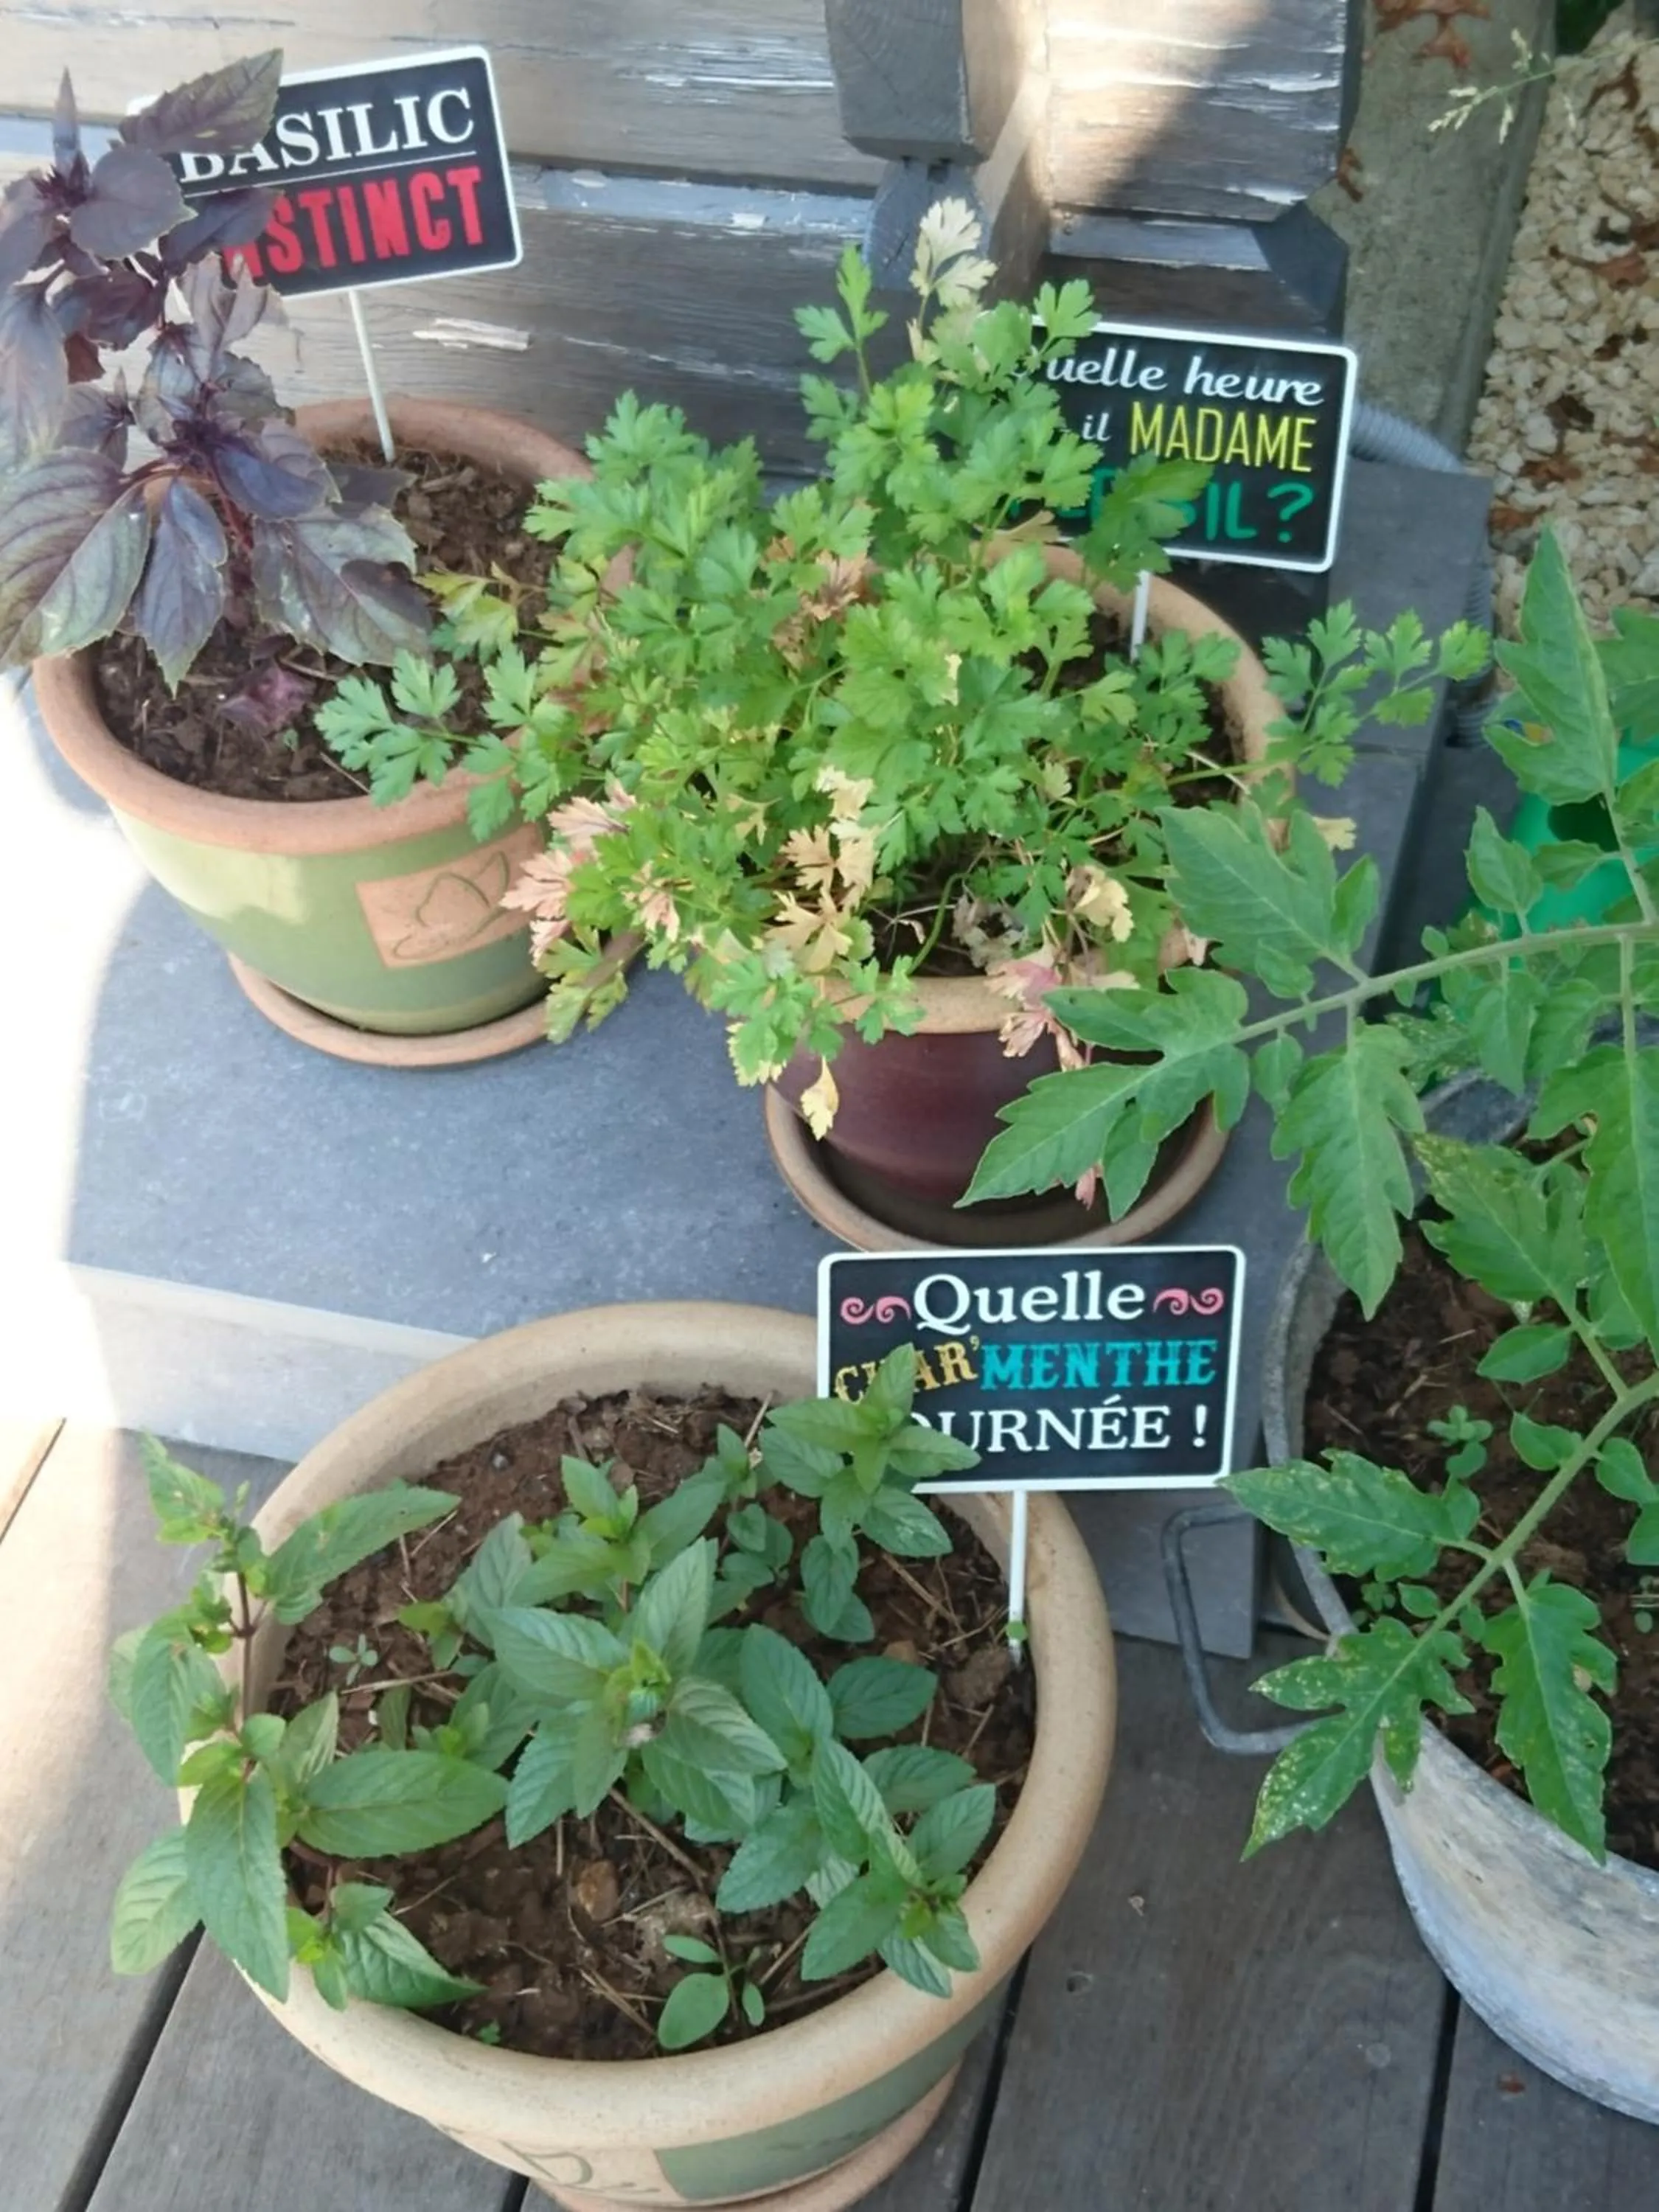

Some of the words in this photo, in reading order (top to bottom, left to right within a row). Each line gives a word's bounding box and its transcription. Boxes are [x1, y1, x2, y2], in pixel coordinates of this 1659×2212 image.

[223, 166, 484, 279] STINCT
[1011, 344, 1169, 392] uelle
[1183, 355, 1326, 406] heure
[1130, 400, 1318, 473] MADAME
[913, 1270, 1147, 1336] Quelle
[833, 1335, 1219, 1405] CAR'MENTHE
[911, 1394, 1171, 1453] URNÉE
